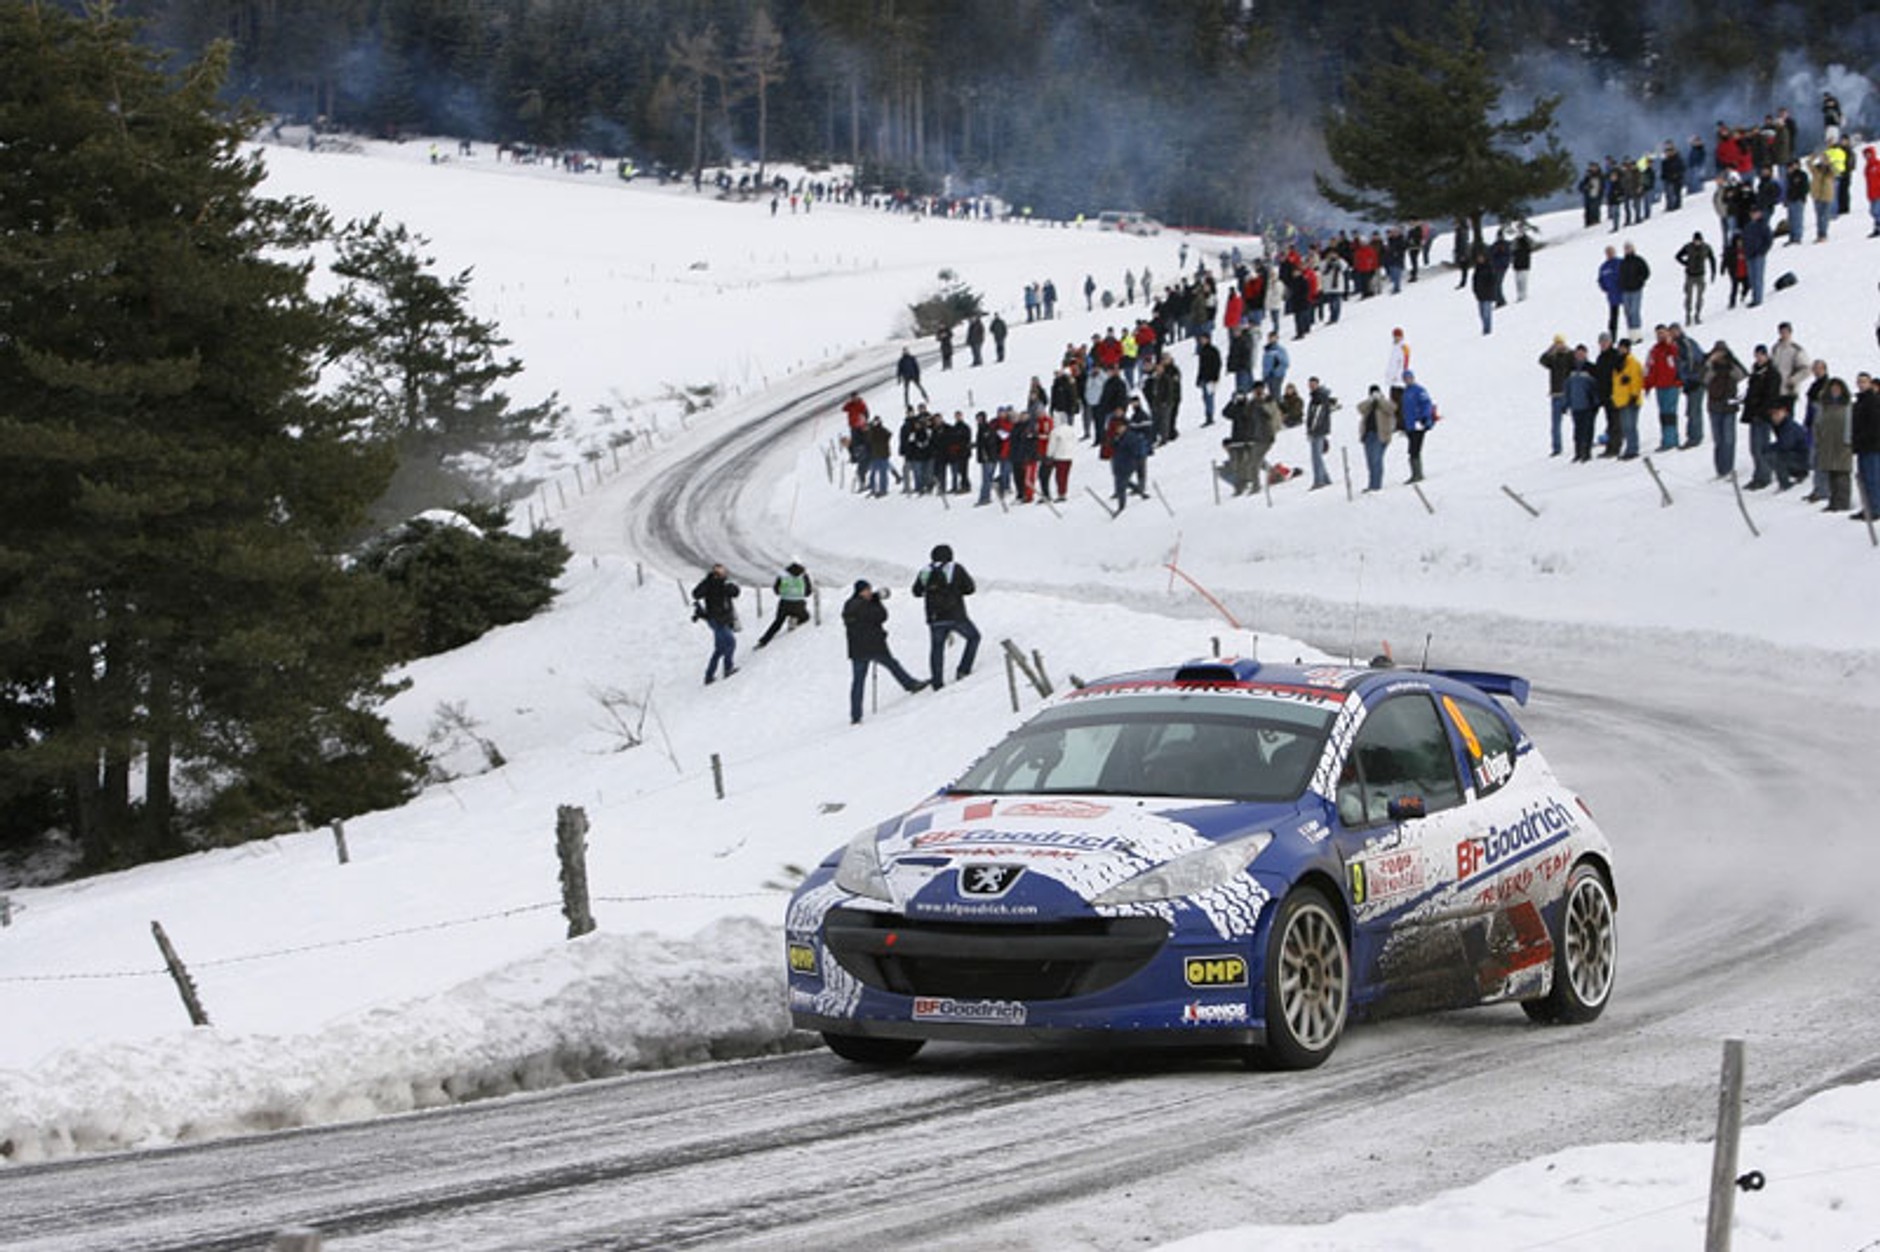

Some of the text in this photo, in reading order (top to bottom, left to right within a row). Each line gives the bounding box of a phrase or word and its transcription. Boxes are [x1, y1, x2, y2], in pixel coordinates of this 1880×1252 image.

[914, 828, 1122, 848] BFGoodrich
[1457, 796, 1574, 881] BFGoodrich
[1352, 863, 1364, 904] 9
[1188, 960, 1243, 983] OMP
[916, 1001, 1024, 1019] BFGoodrich
